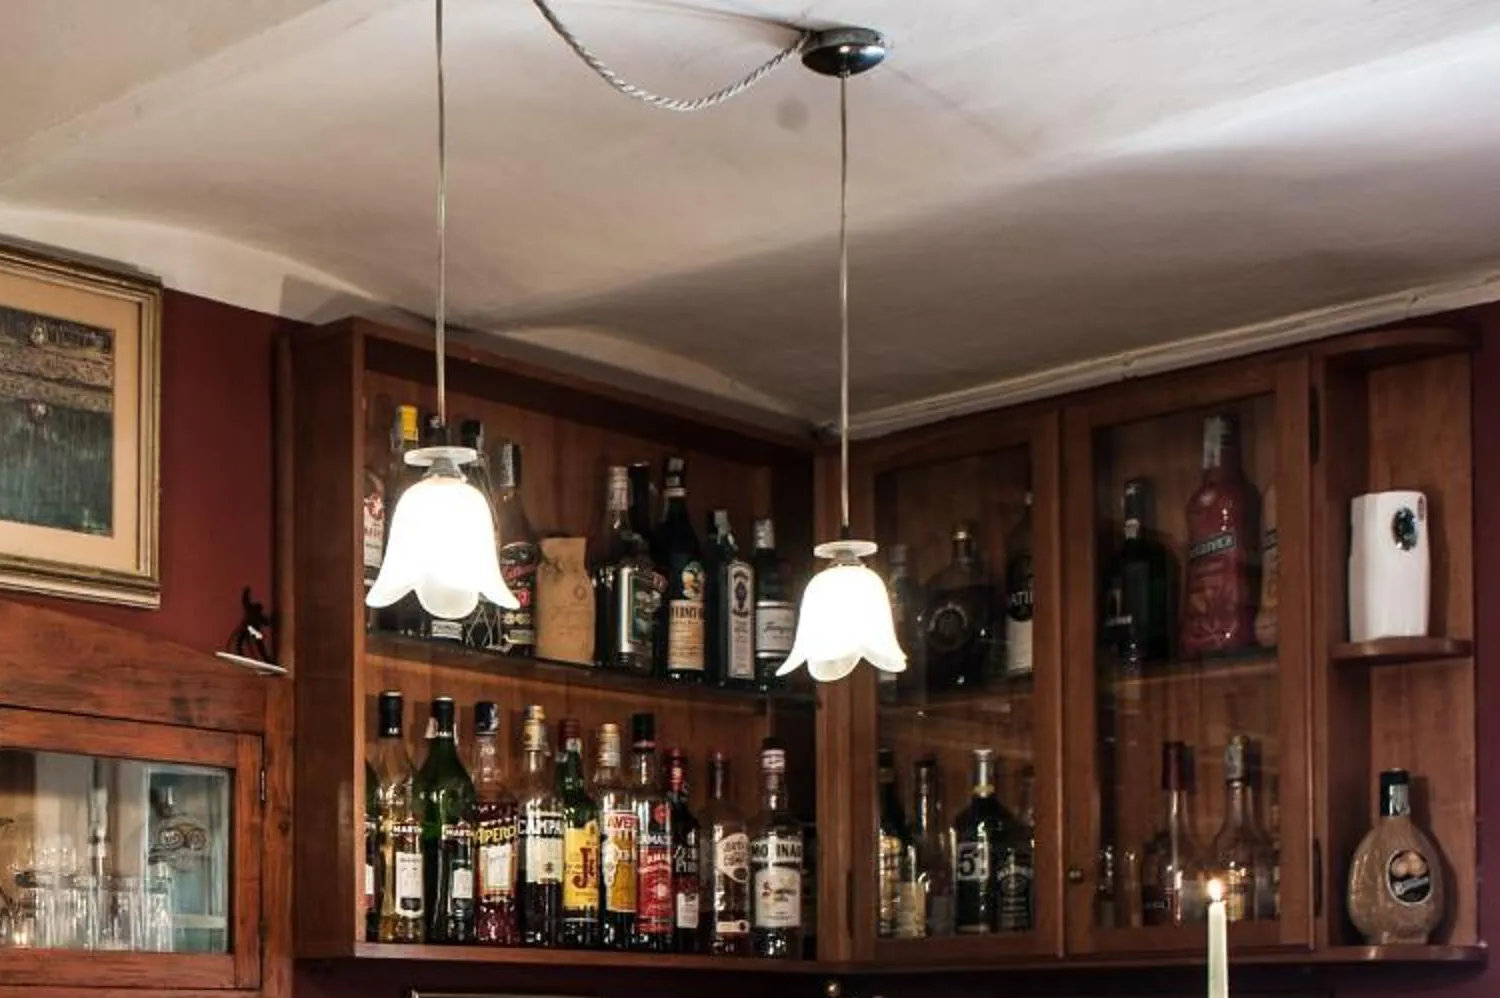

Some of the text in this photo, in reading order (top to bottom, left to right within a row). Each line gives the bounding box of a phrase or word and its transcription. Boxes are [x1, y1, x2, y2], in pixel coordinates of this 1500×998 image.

[475, 824, 517, 844] APERO
[518, 818, 563, 835] CAMPA
[751, 842, 801, 858] MOINA
